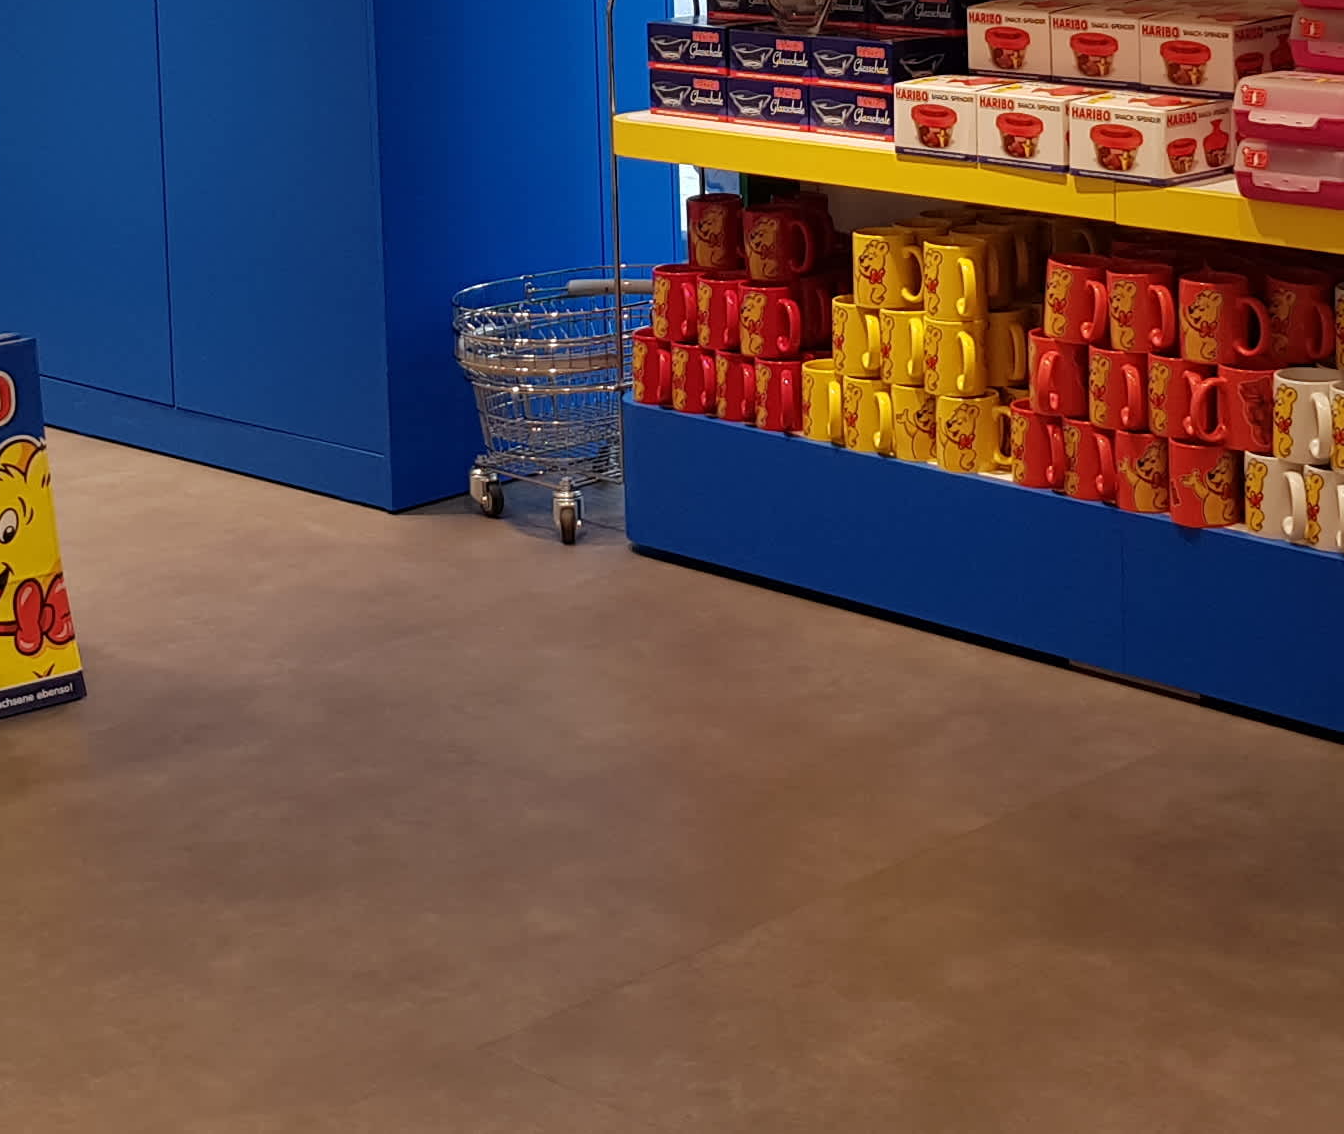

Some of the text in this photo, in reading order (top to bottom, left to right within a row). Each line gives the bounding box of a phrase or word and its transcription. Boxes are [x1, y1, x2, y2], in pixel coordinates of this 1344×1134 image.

[968, 12, 1002, 24] HARIBO
[1053, 17, 1088, 31] HARIBO
[1142, 24, 1180, 38] HARIBO
[690, 43, 724, 60] Glasschale
[772, 51, 809, 68] Glasschale
[853, 58, 889, 76] Glasschale
[690, 88, 724, 106] Glasschale
[896, 88, 929, 102] HARIBO
[770, 97, 805, 116] Glasschale
[979, 96, 1014, 111] HARIBO
[853, 108, 891, 128] Glasschale
[1072, 106, 1110, 122] HARIBO
[1166, 112, 1197, 128] HARIBO
[36, 682, 73, 700] ebenso!
